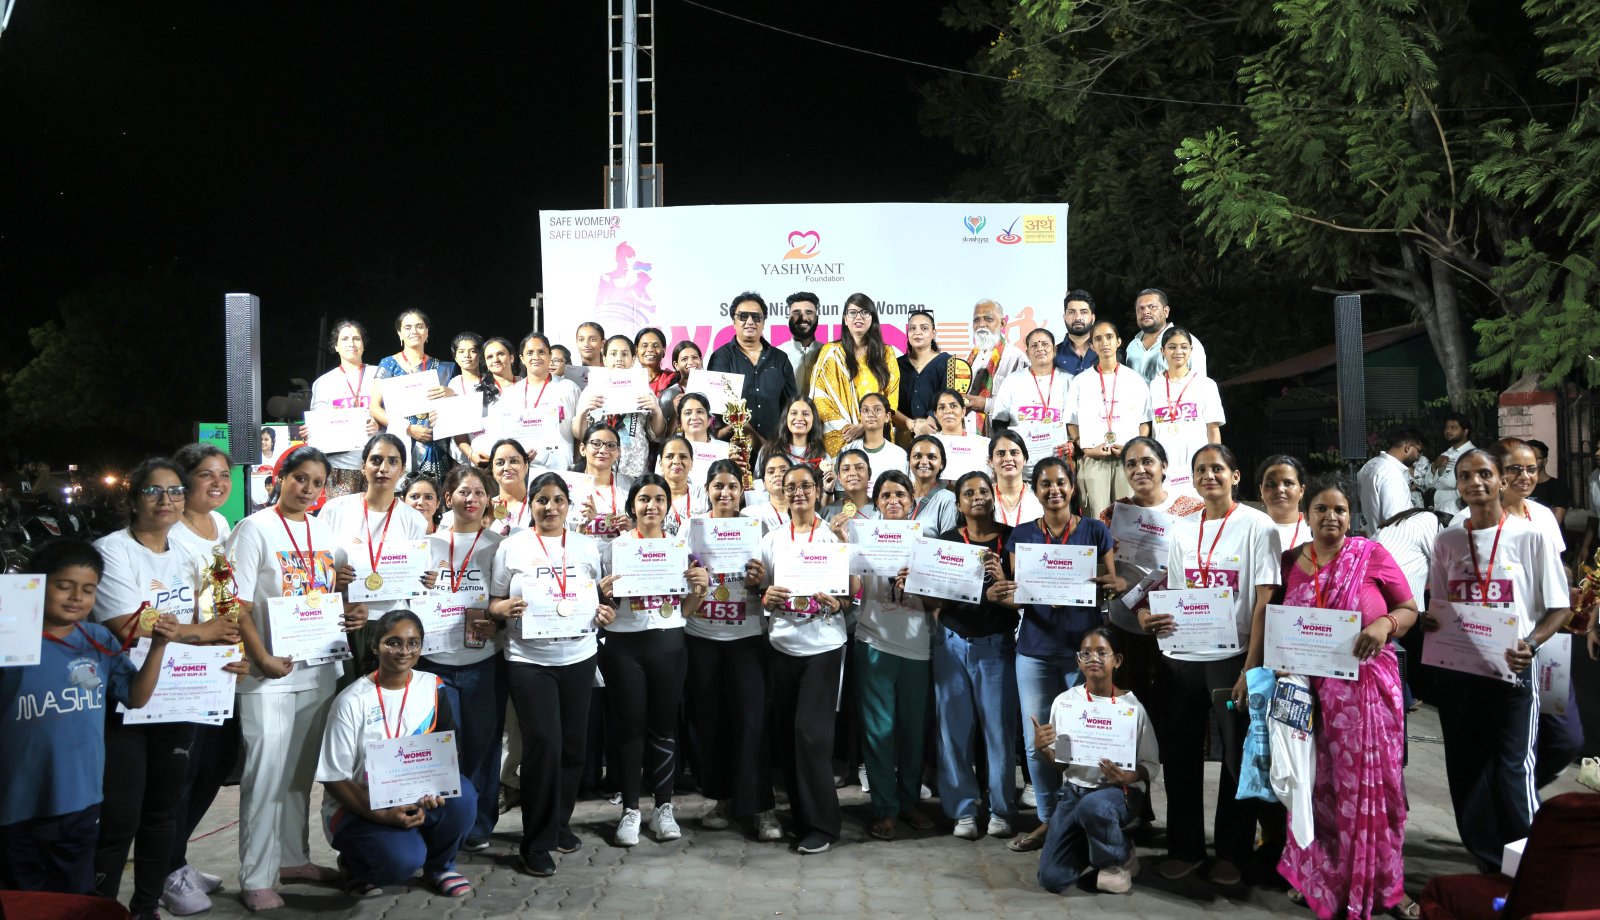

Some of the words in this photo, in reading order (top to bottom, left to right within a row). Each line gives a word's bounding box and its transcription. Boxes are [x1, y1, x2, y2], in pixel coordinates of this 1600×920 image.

[549, 216, 572, 226] SAFE
[574, 216, 611, 226] WOMEN
[1025, 216, 1055, 231] अर्थ
[549, 230, 572, 239] SAFE
[574, 230, 616, 239] UDAIPUR
[760, 263, 845, 275] YASHWANT
[874, 301, 926, 316] Women
[1140, 523, 1165, 533] WOMEN
[940, 554, 964, 564] WOMEN
[440, 570, 481, 581] PFC
[537, 566, 577, 579] PFC
[1456, 582, 1502, 600] 198
[703, 602, 739, 619] 153
[1302, 624, 1332, 633] WOMEN
[1462, 622, 1492, 633] WOMEN
[173, 665, 207, 673] WOMEN
[16, 684, 104, 721] MASHLE
[1086, 718, 1112, 726] WOMEN
[403, 750, 432, 760] WOMEN
